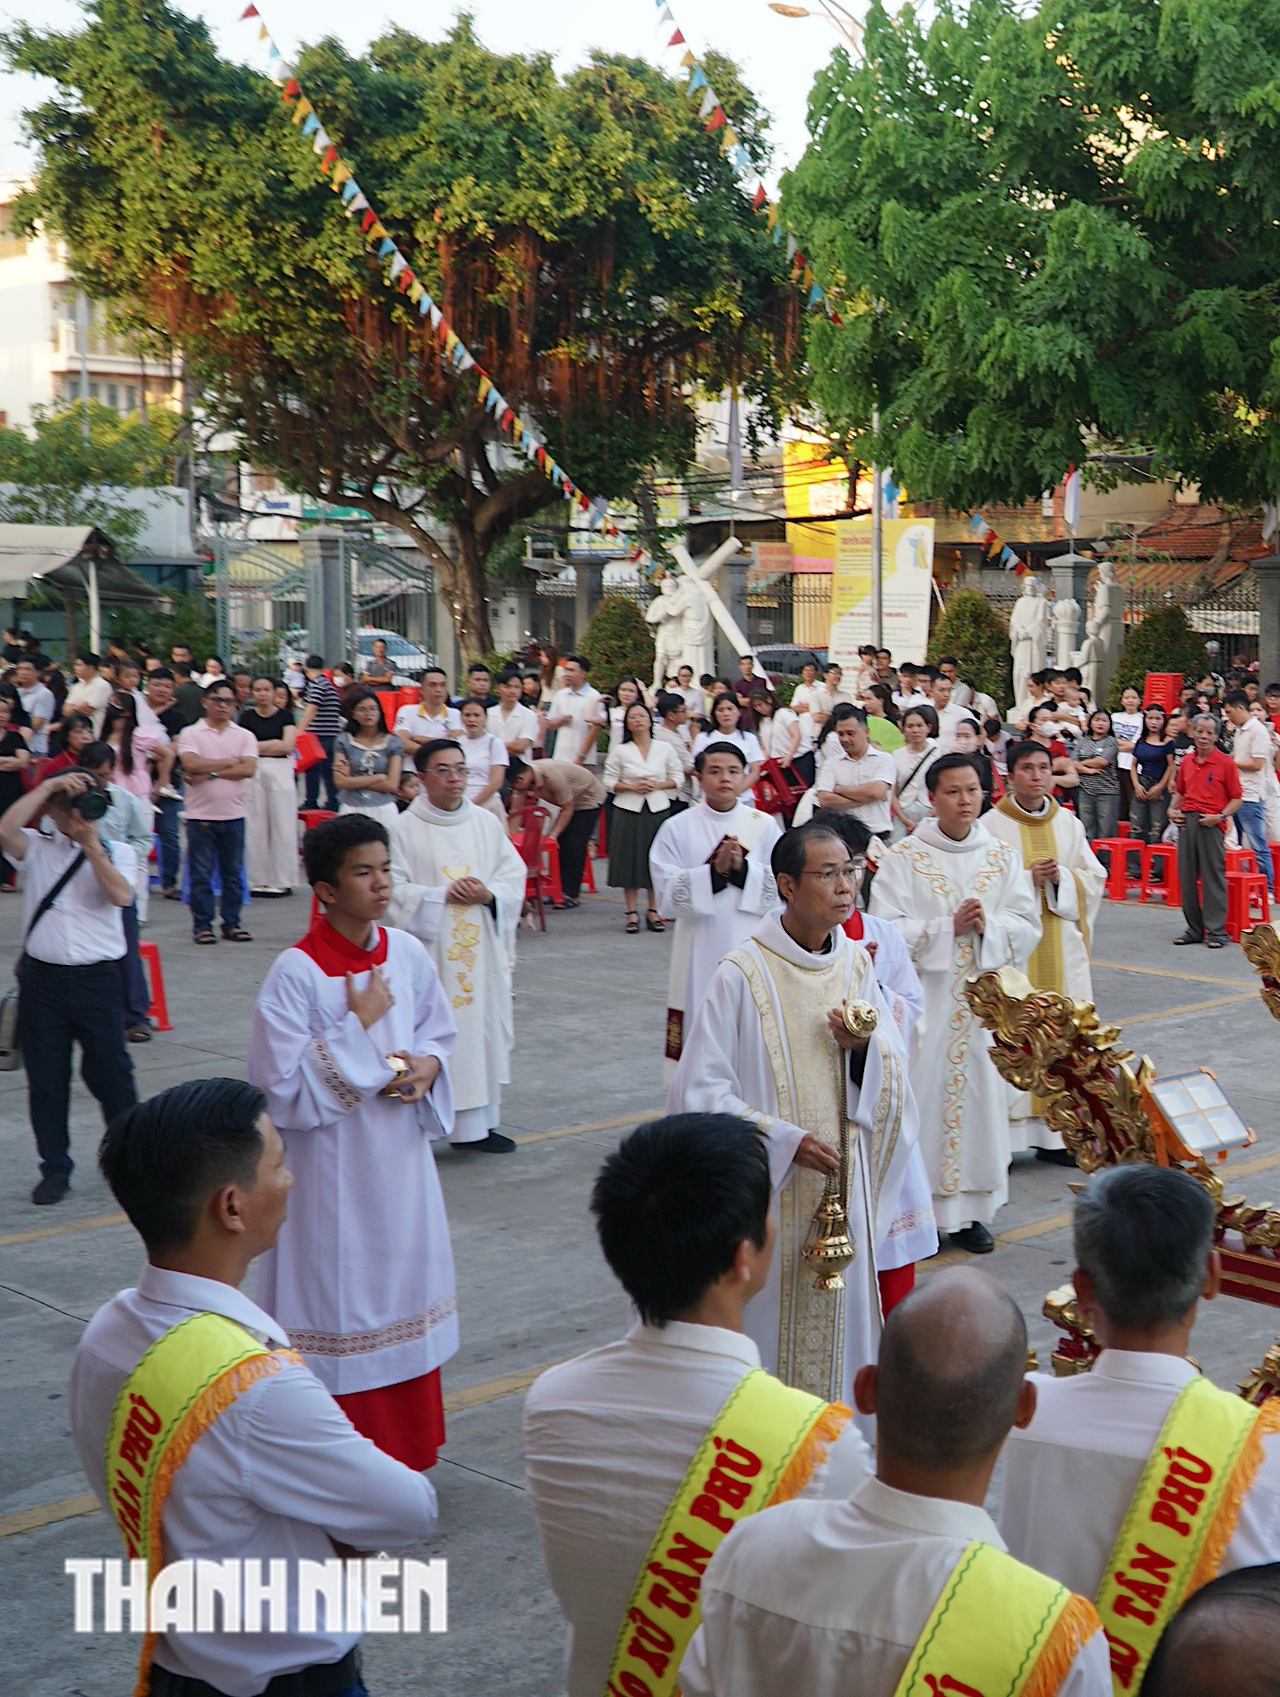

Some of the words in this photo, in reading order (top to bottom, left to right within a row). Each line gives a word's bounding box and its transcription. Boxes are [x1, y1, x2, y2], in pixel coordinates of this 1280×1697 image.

[119, 1392, 162, 1478] PHÚ
[688, 1435, 762, 1534] PHÚ
[648, 1532, 714, 1619] TÂN
[1111, 1543, 1177, 1627] TÂN
[1149, 1445, 1214, 1537] PHÚ
[627, 1606, 675, 1679] XỨ
